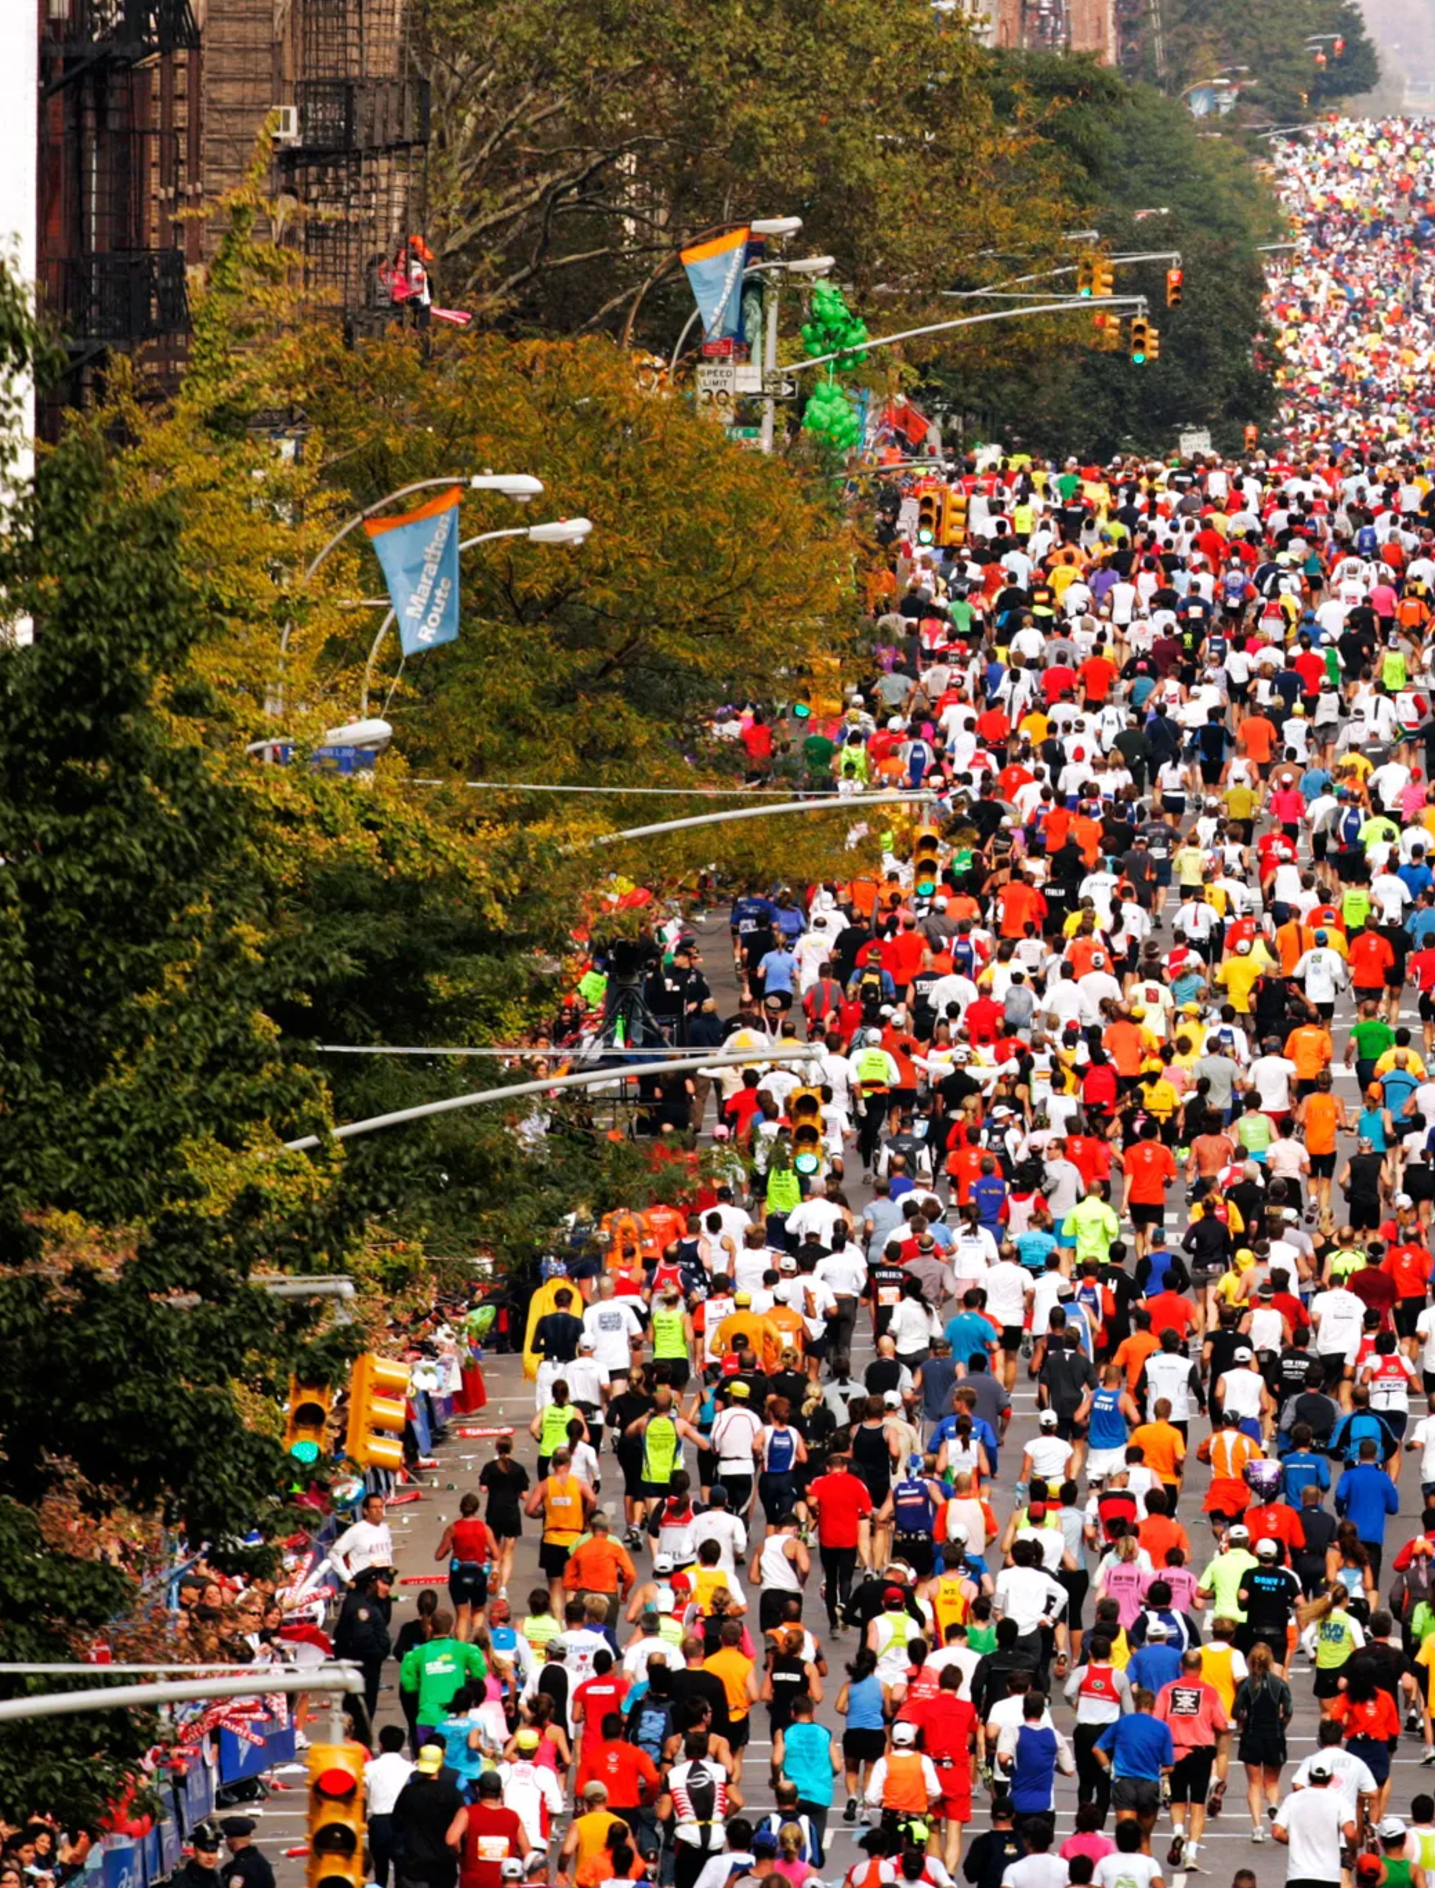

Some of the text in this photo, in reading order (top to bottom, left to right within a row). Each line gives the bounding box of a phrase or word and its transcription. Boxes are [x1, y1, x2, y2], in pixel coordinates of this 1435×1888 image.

[703, 379, 728, 388] LIMIT
[405, 514, 451, 620] Marathon
[417, 577, 452, 643] Route
[875, 1271, 904, 1279] DRIES
[568, 1643, 599, 1654] Israel
